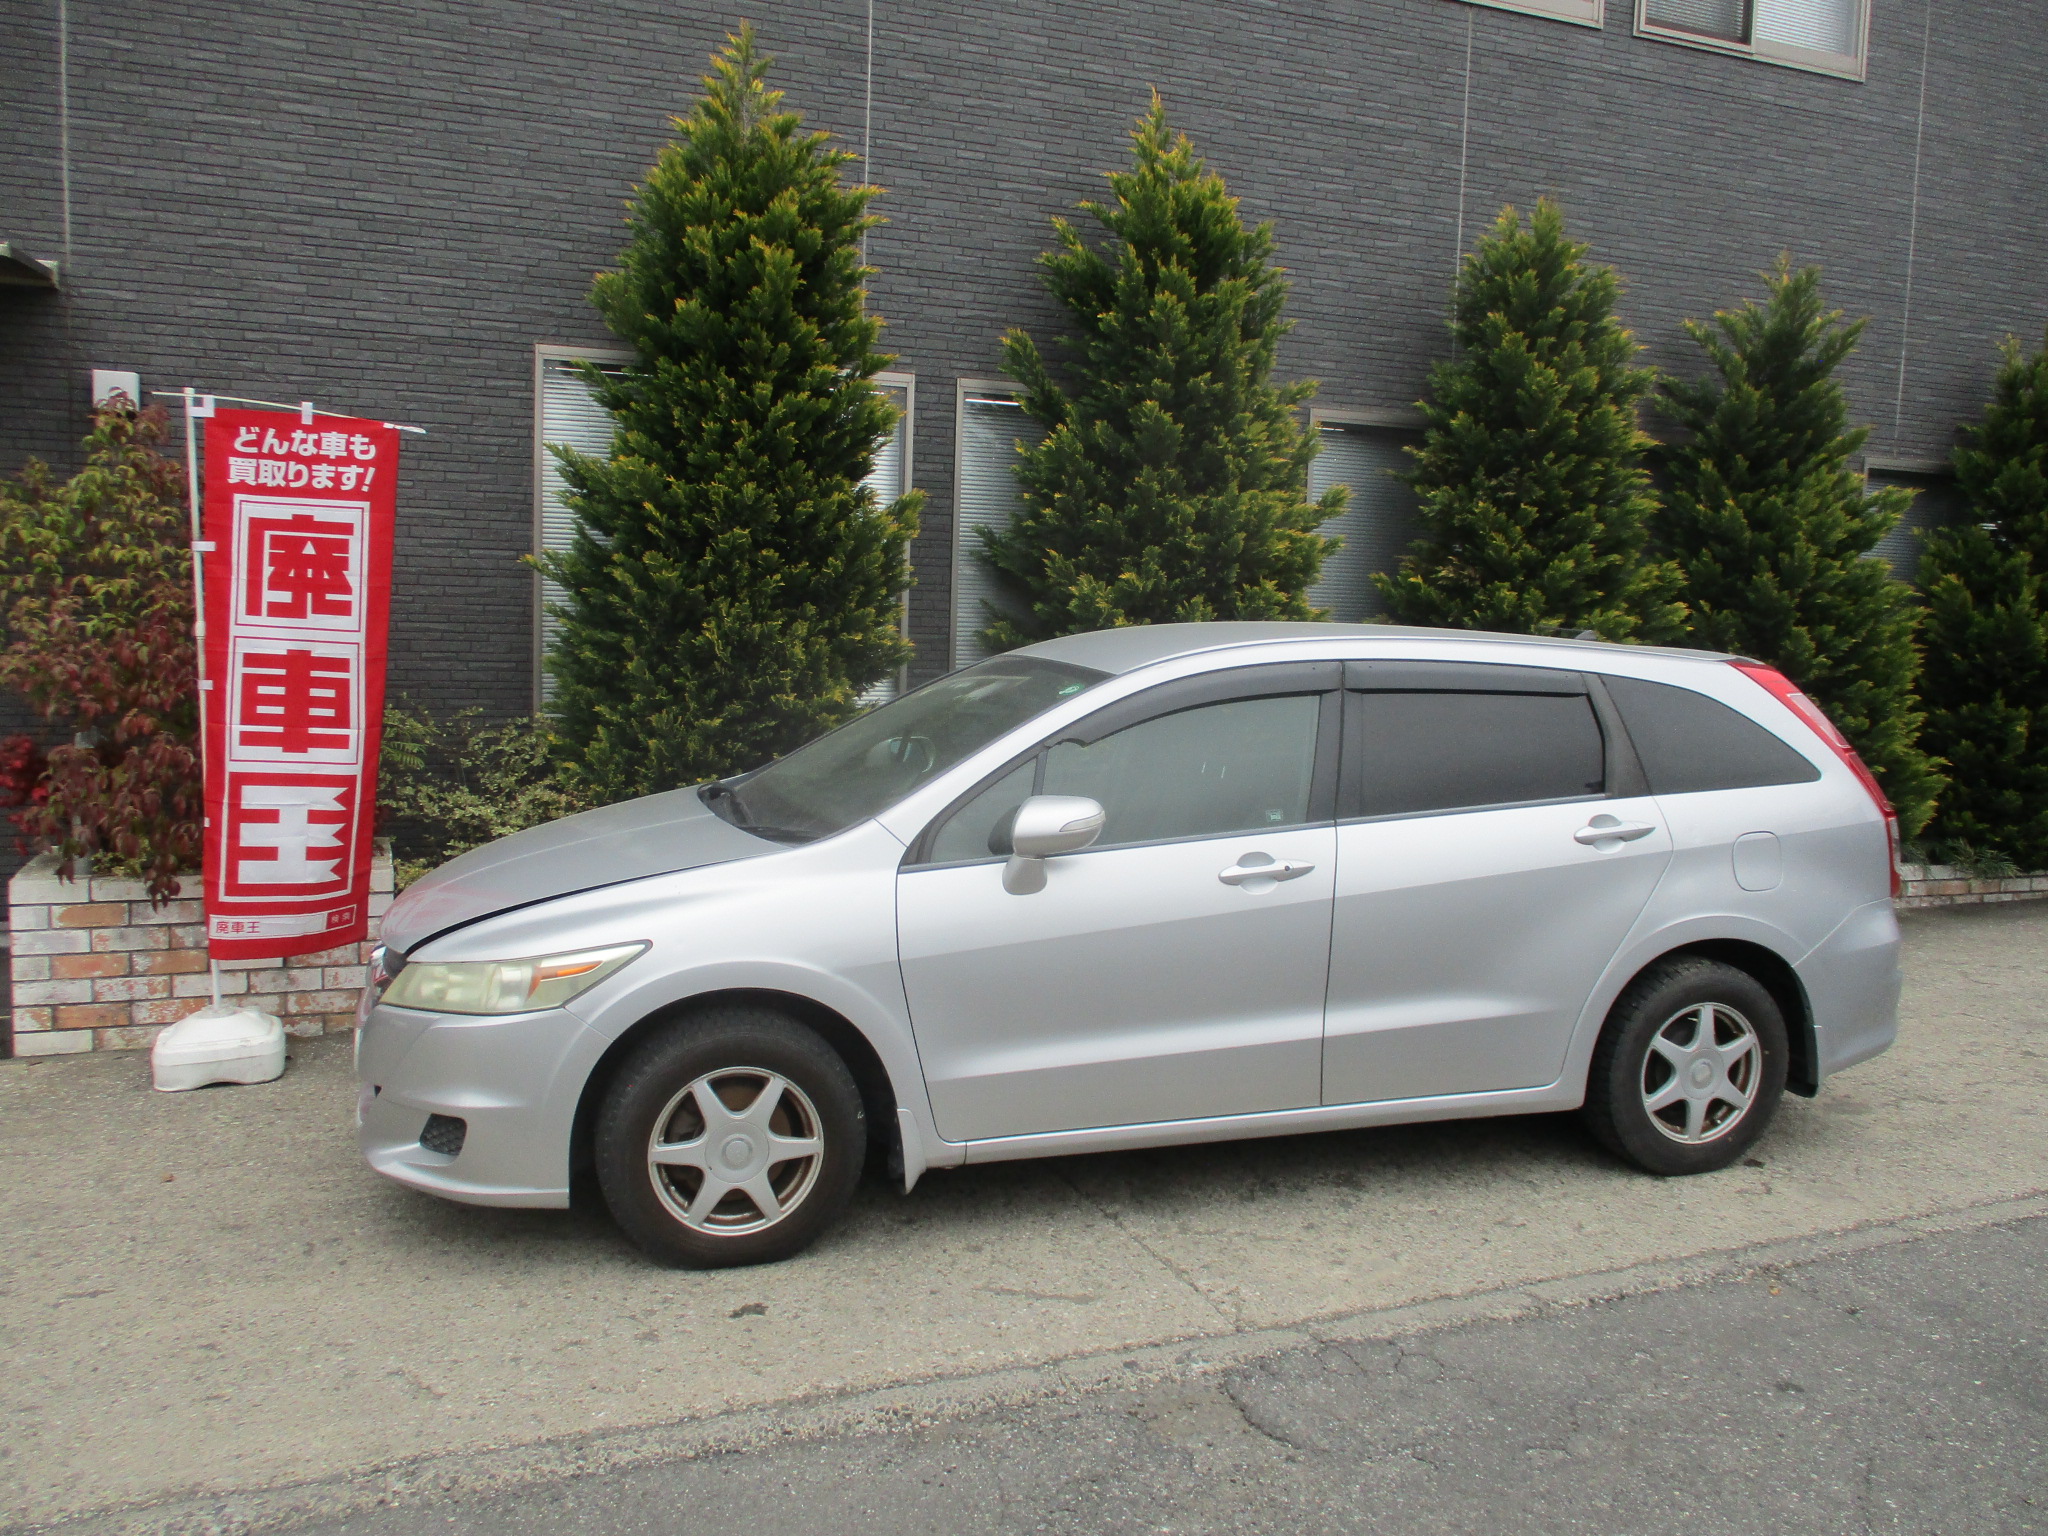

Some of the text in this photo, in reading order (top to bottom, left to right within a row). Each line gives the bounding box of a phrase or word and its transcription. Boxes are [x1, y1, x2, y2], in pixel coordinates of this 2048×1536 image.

[234, 426, 376, 460] どんな車も
[227, 456, 375, 492] 買取ります!
[238, 513, 354, 884] 廃車王
[215, 920, 261, 934] 廃車王
